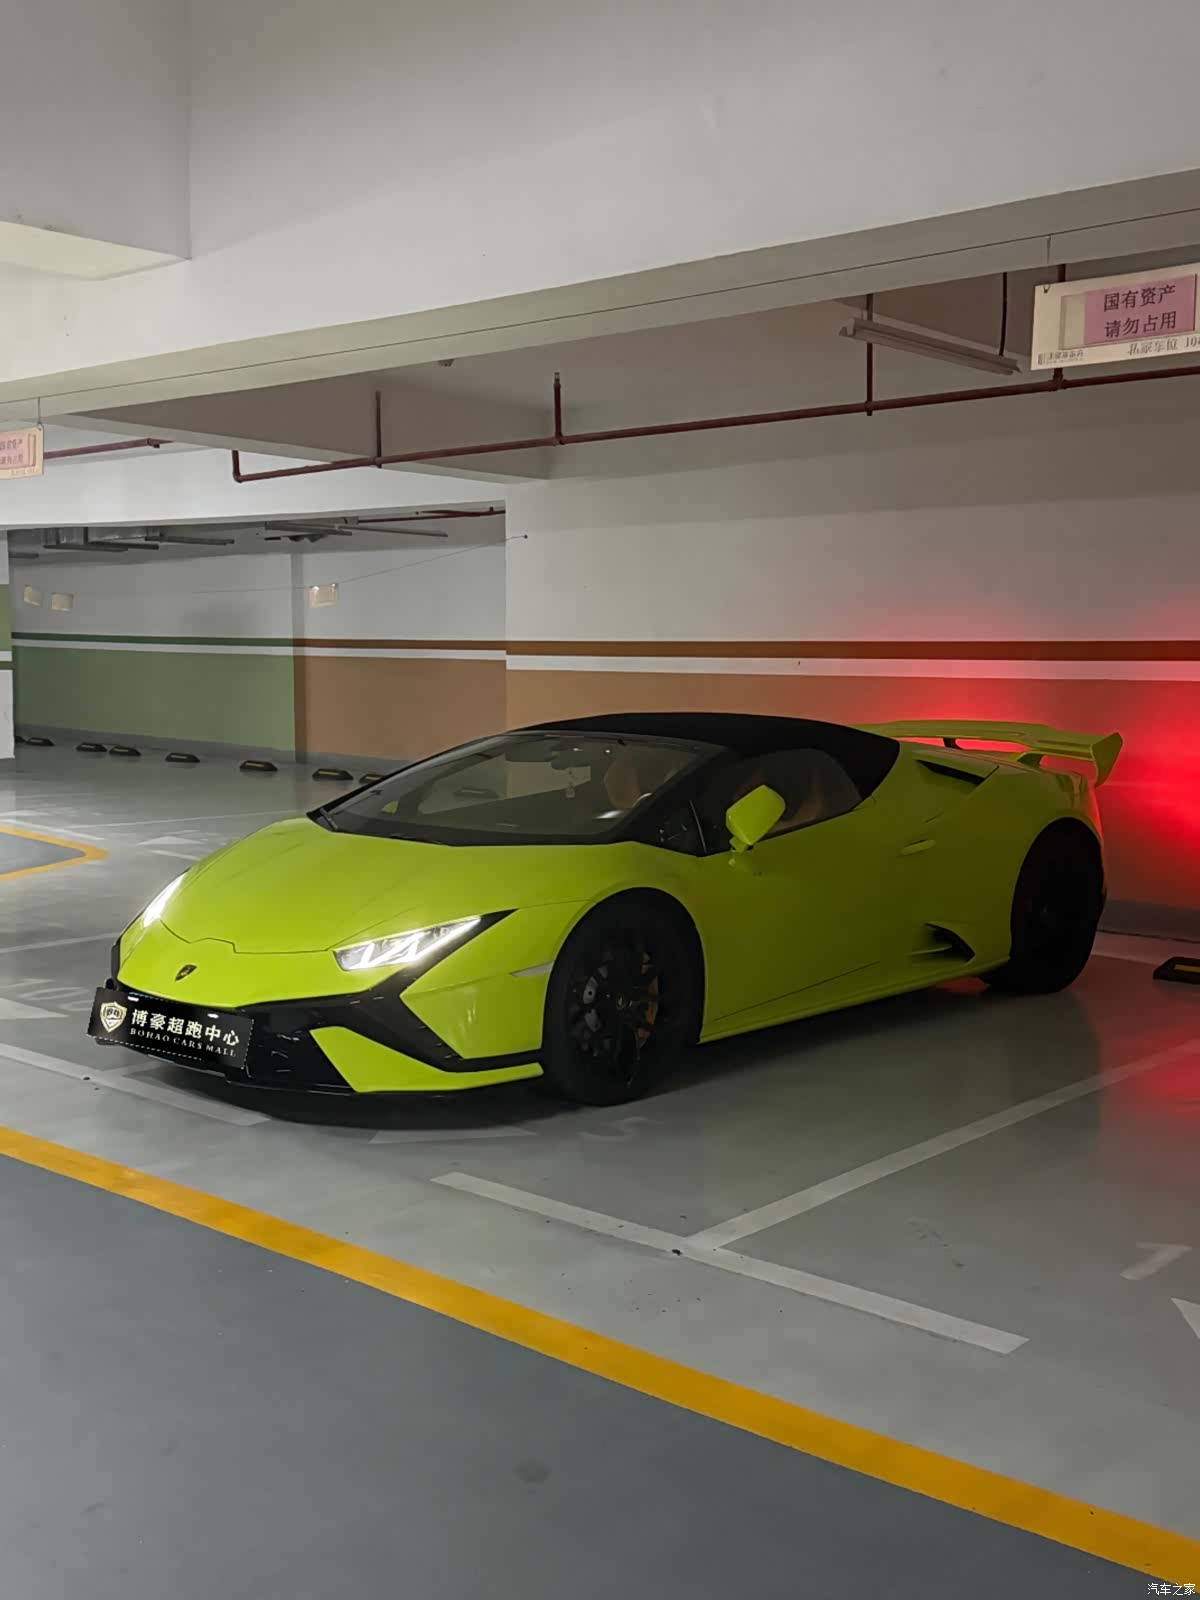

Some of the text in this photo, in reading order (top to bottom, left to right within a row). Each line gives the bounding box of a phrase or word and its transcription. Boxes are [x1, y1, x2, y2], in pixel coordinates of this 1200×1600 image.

[1103, 284, 1176, 312] 国有资产
[1104, 311, 1177, 338] 请勿占用
[1184, 336, 1200, 349] 10
[130, 1008, 240, 1047] 博豪超跑中心
[129, 1027, 237, 1058] BOHAO CARS MALL
